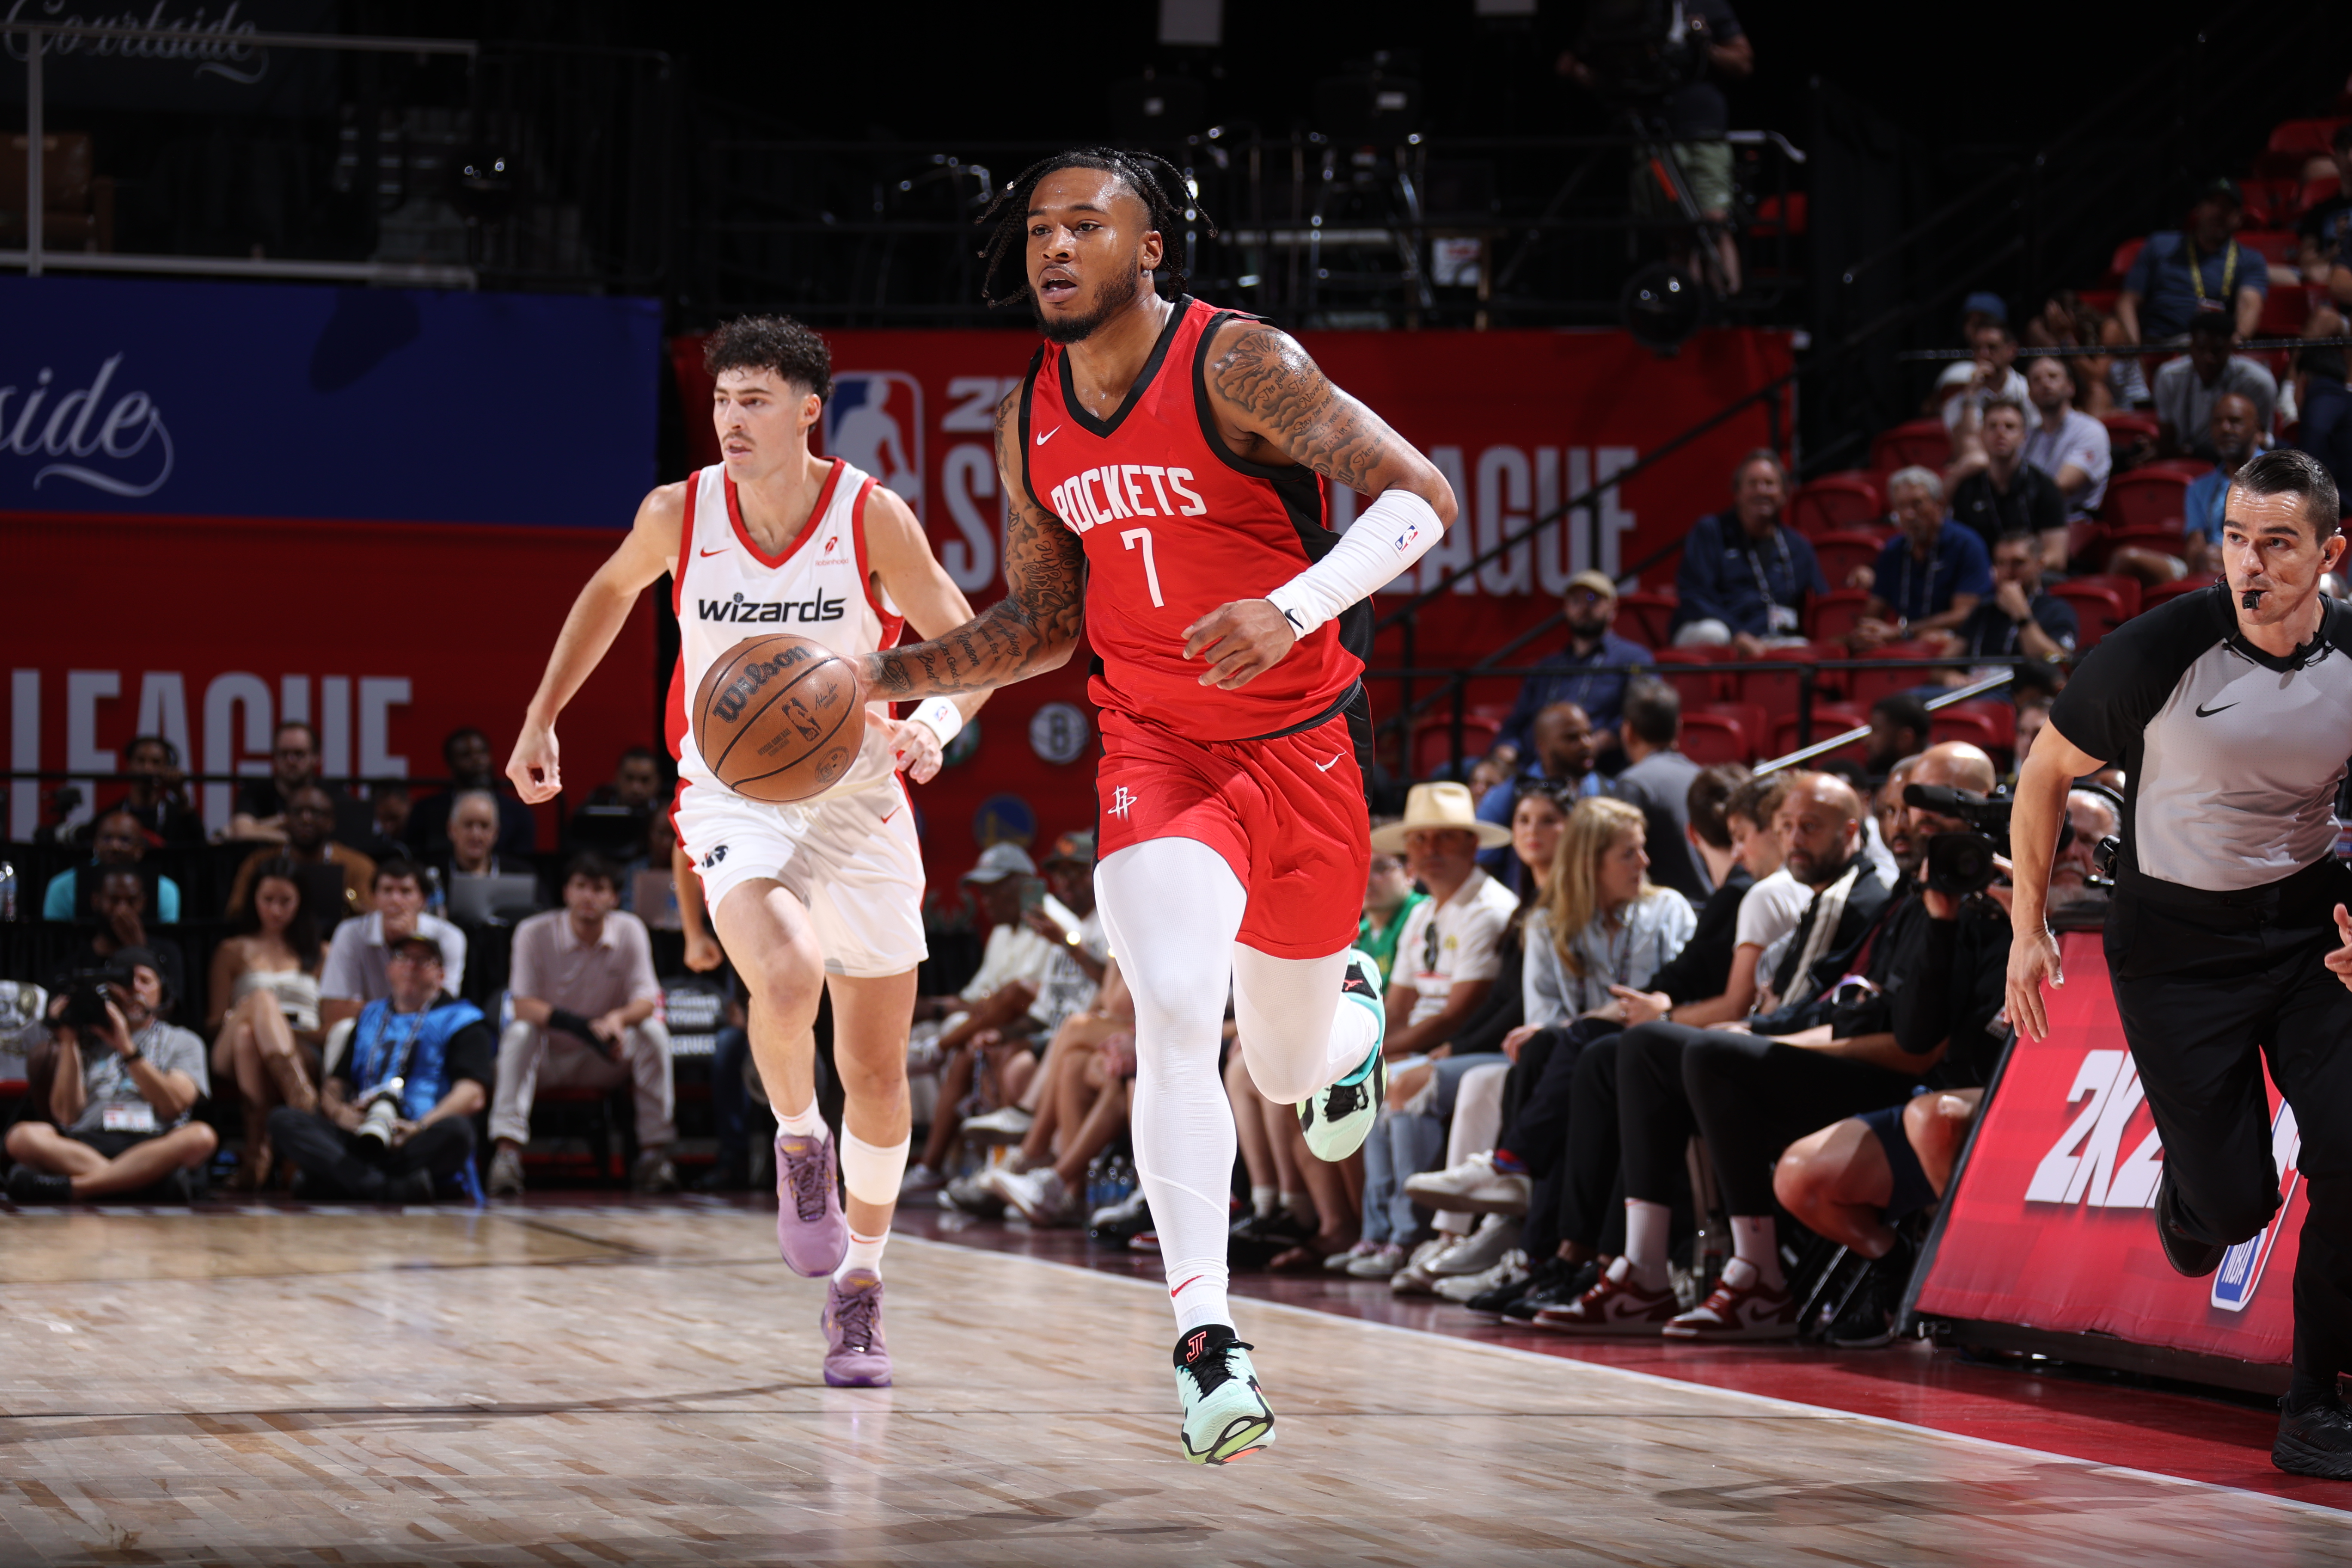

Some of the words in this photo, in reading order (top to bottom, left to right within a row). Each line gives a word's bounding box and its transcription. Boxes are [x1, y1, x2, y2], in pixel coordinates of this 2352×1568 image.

[1257, 386, 1275, 401] The
[1298, 385, 1320, 409] Never
[1294, 416, 1312, 434] Stay
[1312, 407, 1323, 418] ten
[1321, 396, 1331, 409] toes
[1314, 423, 1329, 437] It's
[1328, 412, 1339, 424] not
[1323, 435, 1340, 450] It's
[1337, 427, 1347, 435] in
[1345, 416, 1357, 429] you
[1353, 444, 1375, 466] They
[1050, 464, 1207, 536] ROCKETS
[815, 558, 849, 566] Robinhood
[1119, 527, 1164, 608] 7
[698, 586, 847, 622] wizards
[953, 630, 980, 667] Reason
[989, 643, 999, 655] for
[916, 652, 940, 681] Bad
[946, 657, 961, 679] Good
[712, 645, 812, 723] Wilson
[2024, 1050, 2158, 1209] 2K2
